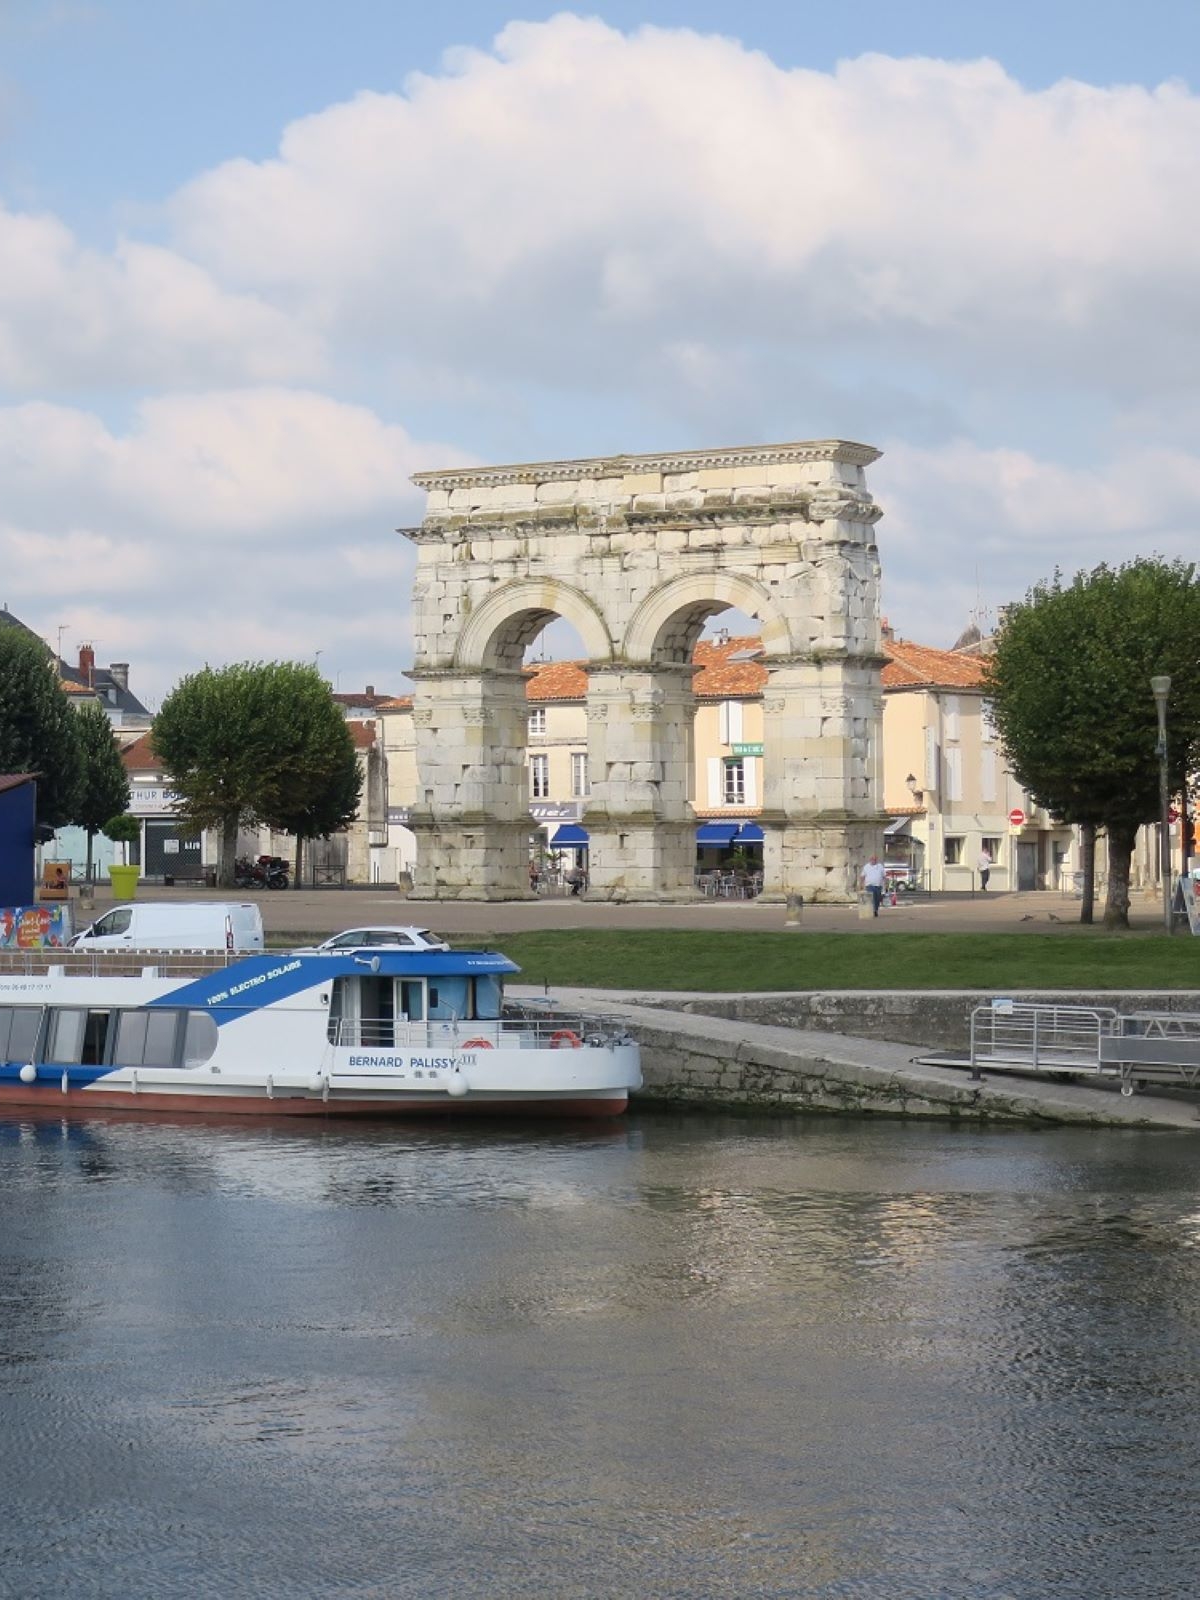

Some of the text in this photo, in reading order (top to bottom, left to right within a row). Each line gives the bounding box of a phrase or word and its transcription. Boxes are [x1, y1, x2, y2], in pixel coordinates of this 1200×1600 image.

[207, 959, 302, 1005] 100% ELECTRO SOLAIRE
[349, 1056, 403, 1068] BERNARD
[410, 1058, 456, 1069] PALISSY
